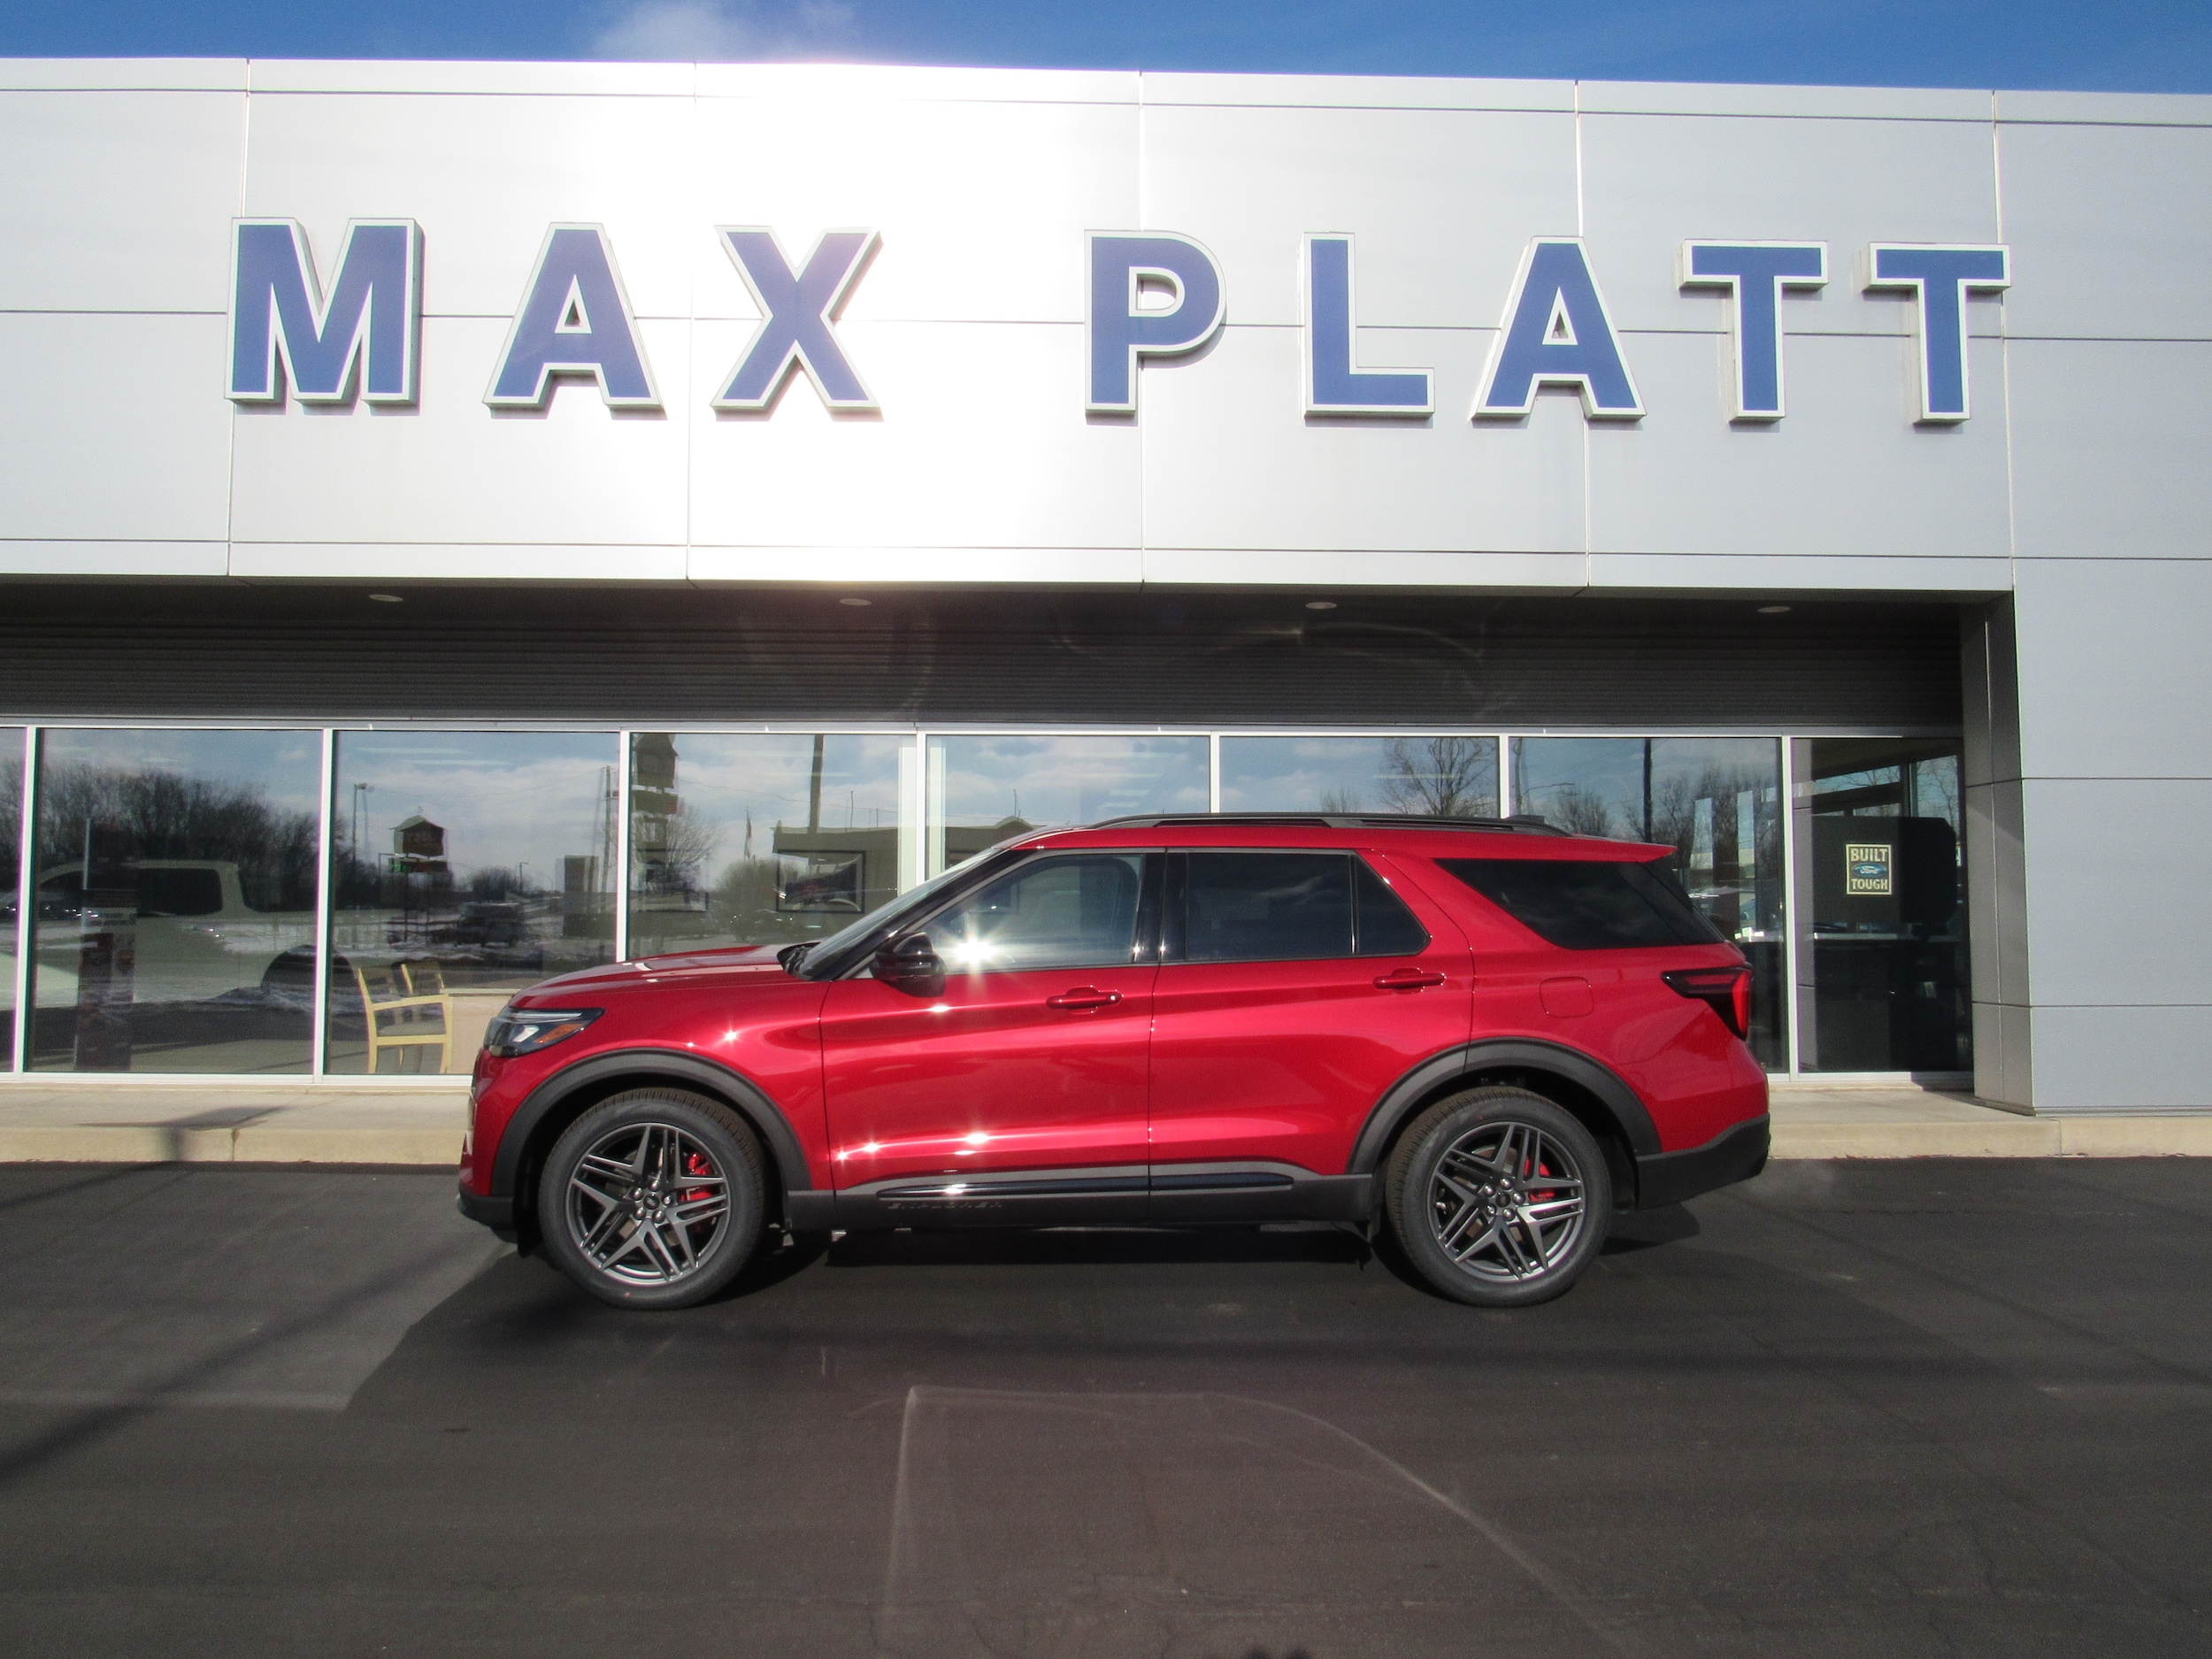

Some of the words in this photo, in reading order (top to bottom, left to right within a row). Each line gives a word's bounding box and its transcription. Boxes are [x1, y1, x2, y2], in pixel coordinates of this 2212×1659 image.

[226, 217, 884, 411] MAX
[1084, 229, 2011, 422] PLATT
[1850, 848, 1887, 862] BUILT
[1851, 879, 1888, 890] TOUGH
